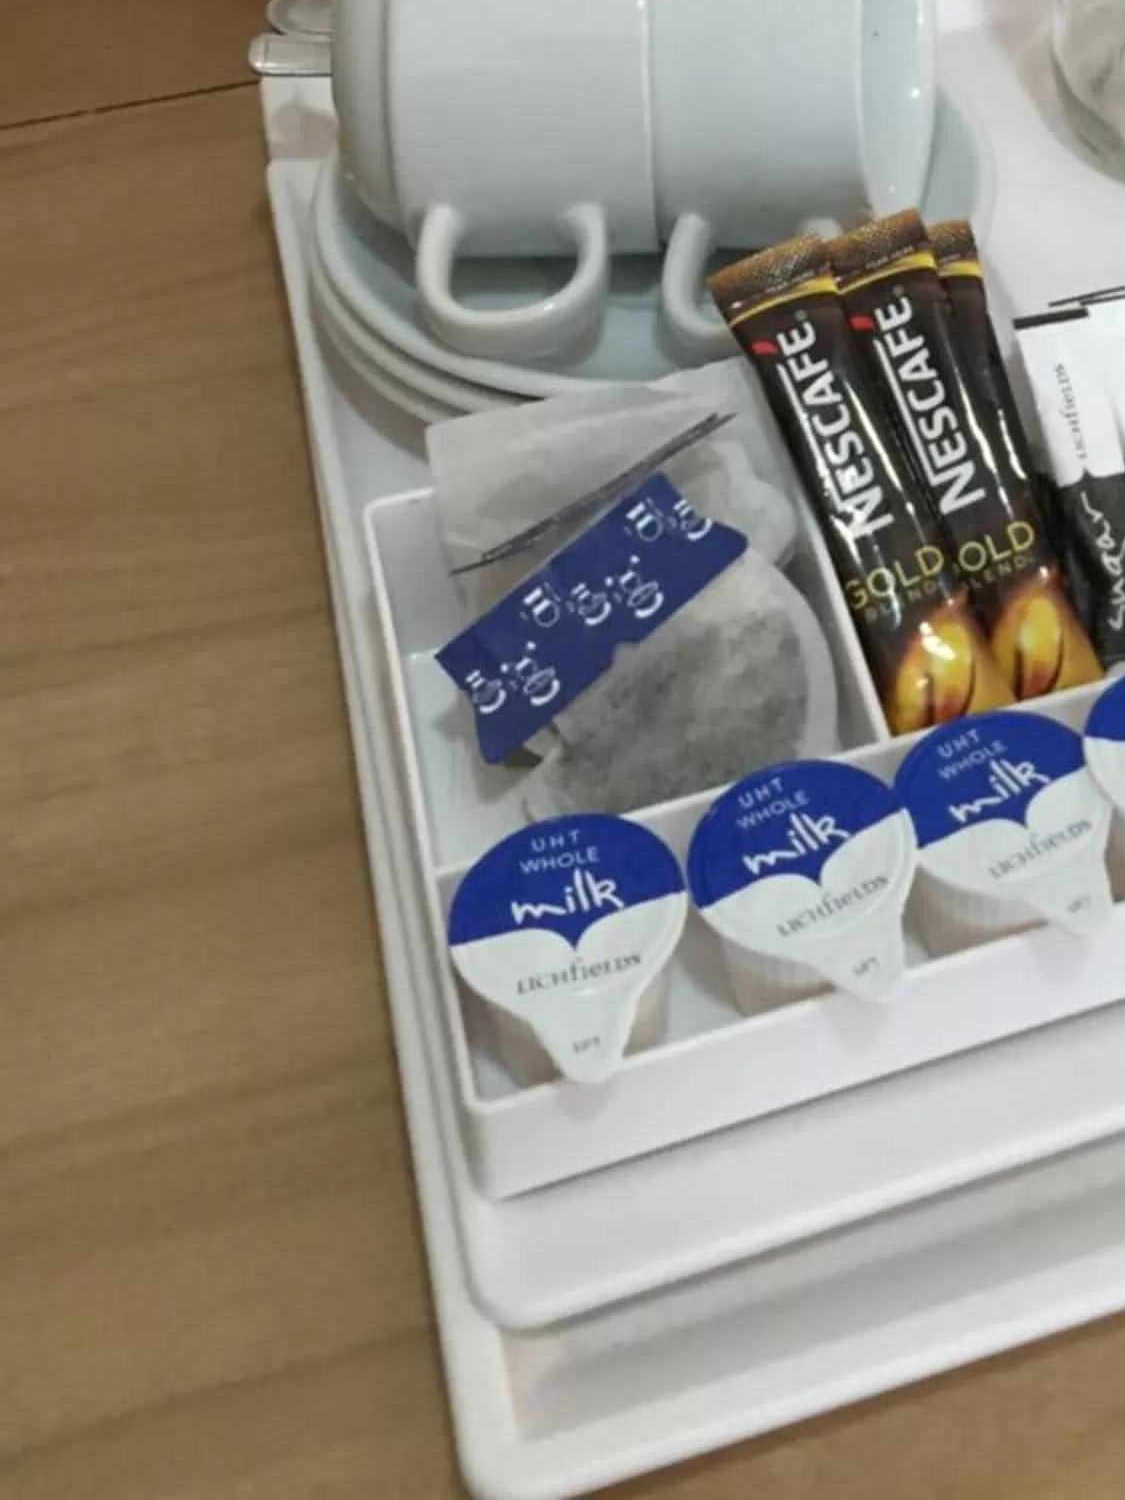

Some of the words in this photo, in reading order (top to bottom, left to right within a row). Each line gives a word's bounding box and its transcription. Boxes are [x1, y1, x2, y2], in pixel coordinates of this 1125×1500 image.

[954, 520, 1035, 573] OLD
[846, 545, 945, 610] GOLD
[937, 728, 981, 759] UHT
[937, 740, 1008, 780] WHOLE
[736, 790, 810, 830] WHOLE
[737, 777, 785, 809] UHT
[949, 759, 1050, 822] milk
[519, 846, 600, 875] WHOLE
[530, 829, 581, 853] UHT
[742, 813, 851, 875] milk
[510, 868, 625, 925] milk
